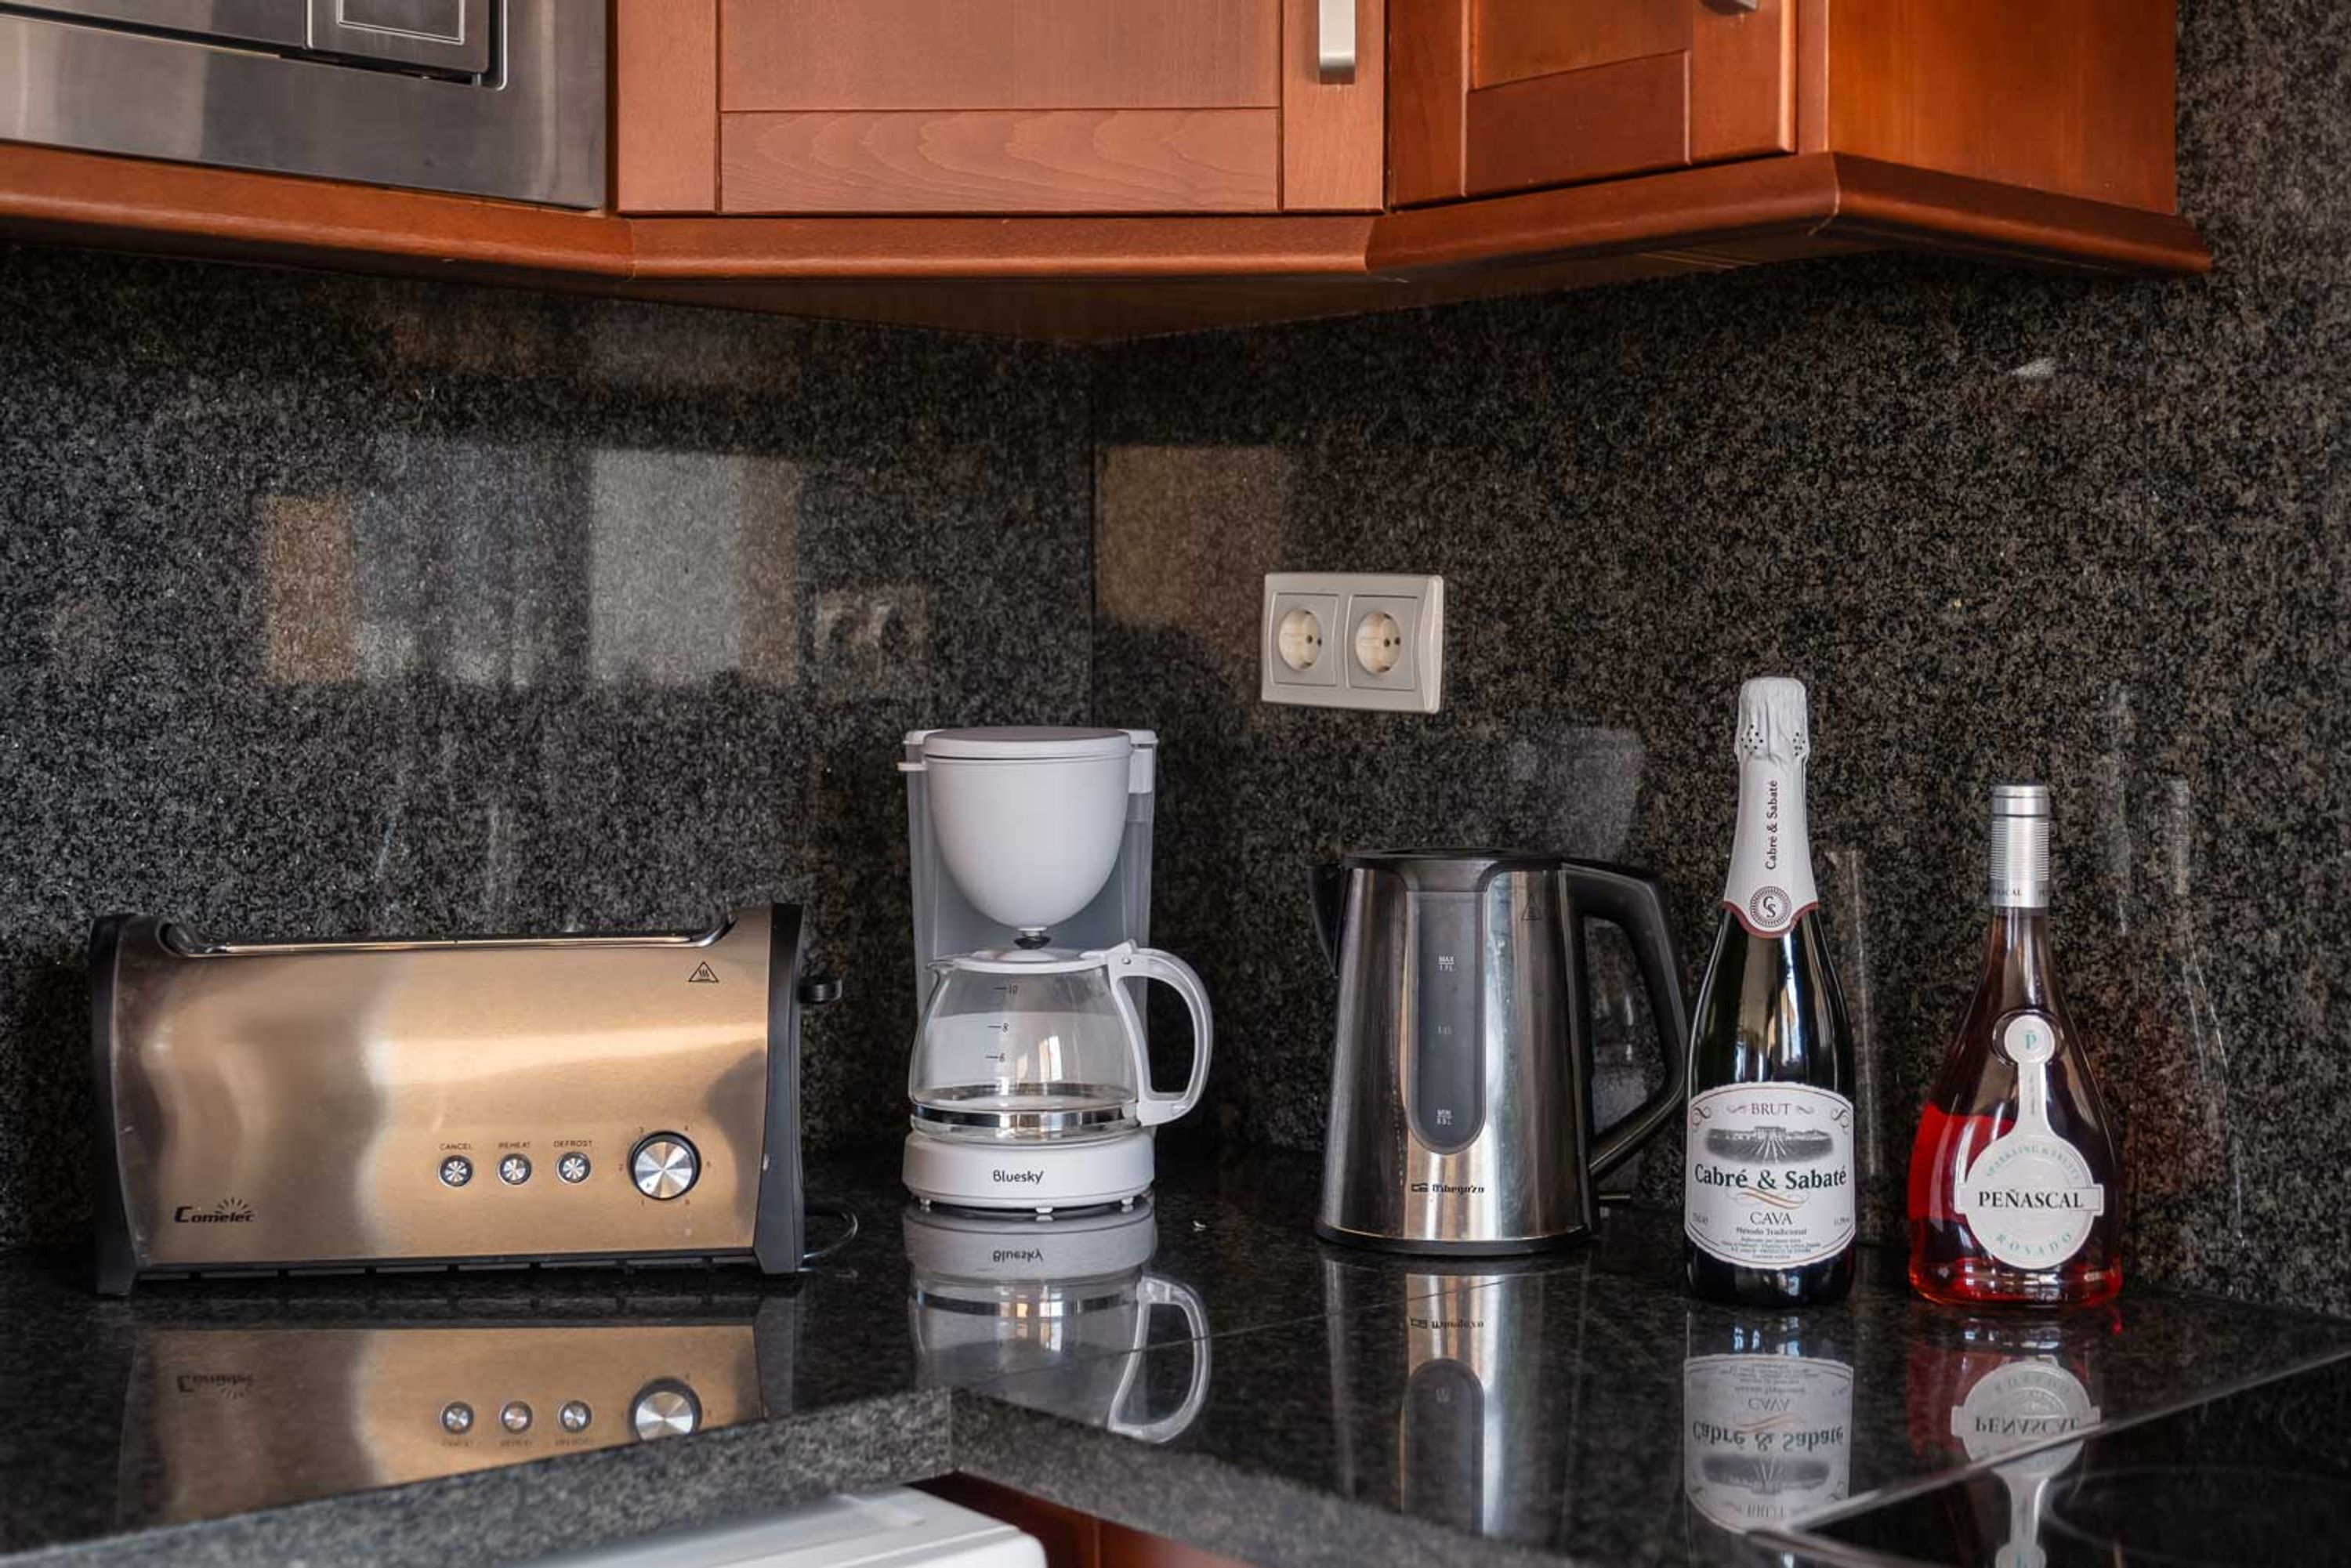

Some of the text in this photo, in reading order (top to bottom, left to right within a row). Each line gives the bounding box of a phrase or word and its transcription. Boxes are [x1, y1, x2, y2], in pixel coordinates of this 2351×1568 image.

[1766, 822, 1777, 833] &
[1751, 1103, 1792, 1115] BRUT
[498, 1141, 531, 1150] REHEAT
[553, 1139, 592, 1148] DEFROST
[992, 1169, 1045, 1185] Bluesky
[1694, 1164, 1847, 1190] Cabré & Sabaté
[1978, 1189, 2084, 1209] PEÑASCAL
[1750, 1211, 1793, 1225] CAVA
